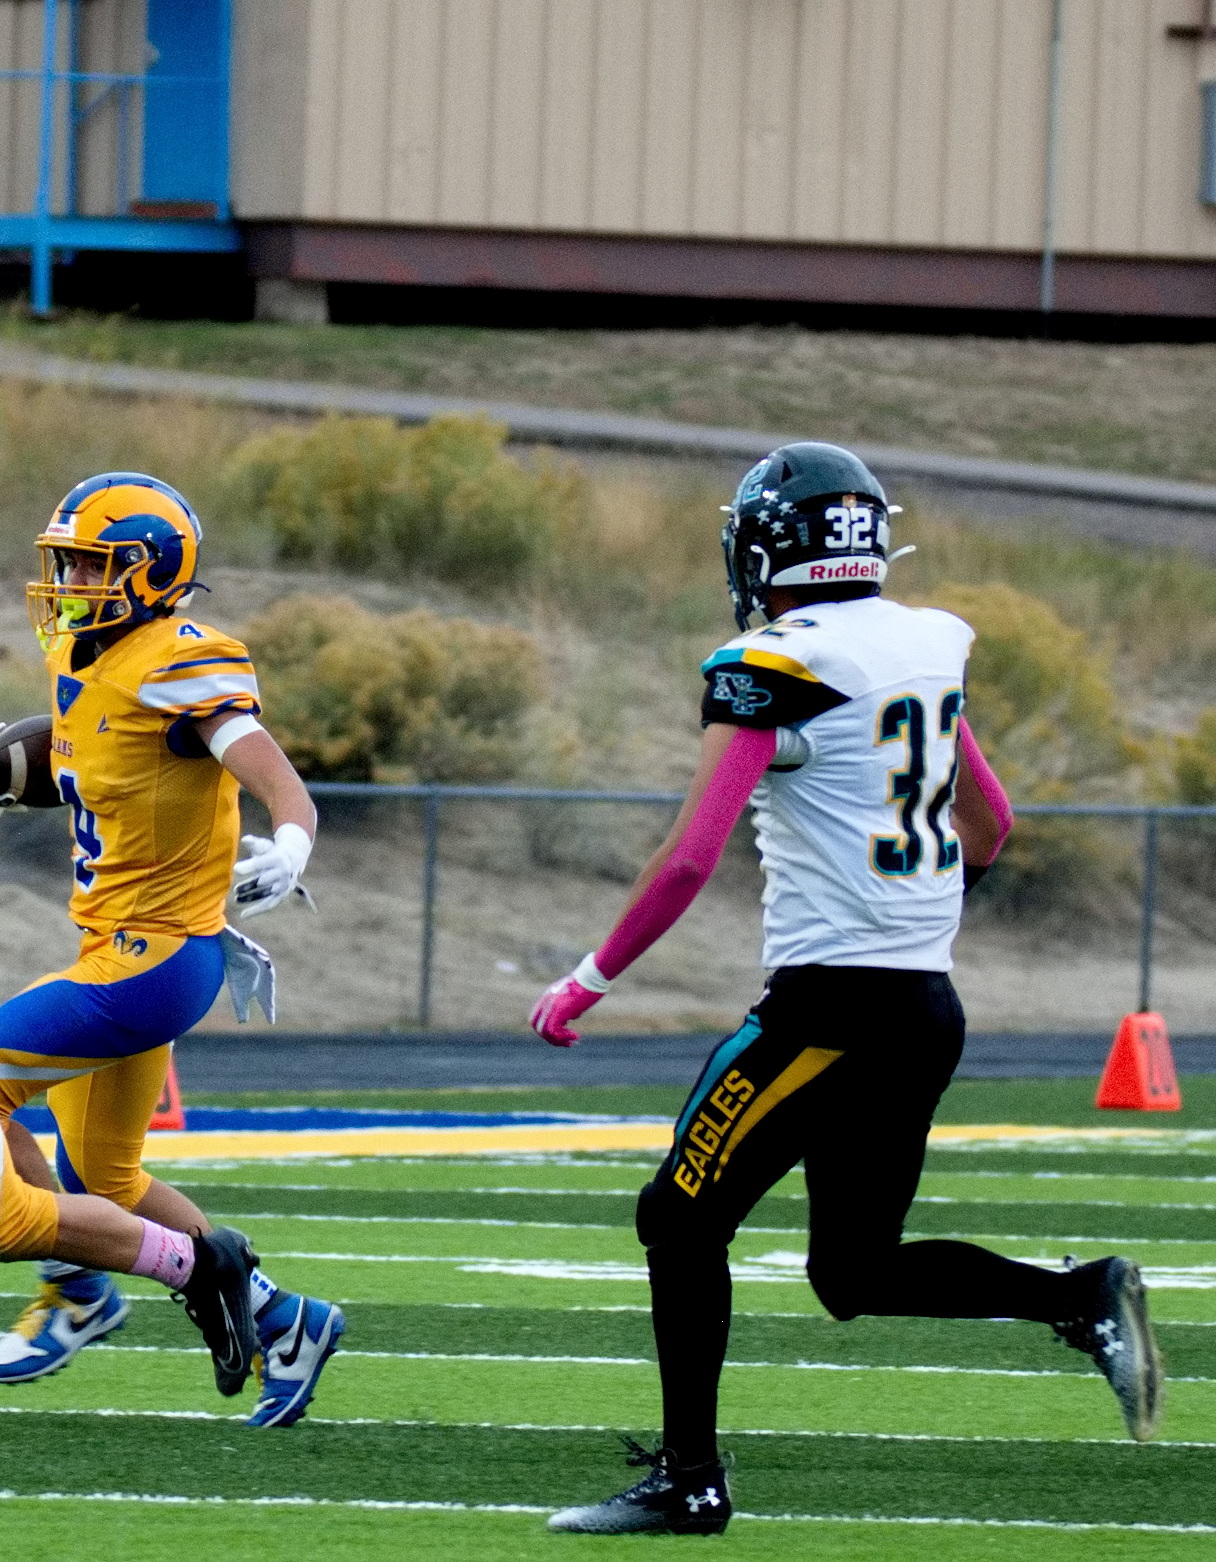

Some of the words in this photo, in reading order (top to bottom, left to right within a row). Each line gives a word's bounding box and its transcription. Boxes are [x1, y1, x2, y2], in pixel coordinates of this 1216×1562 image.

[825, 507, 872, 549] 32
[809, 562, 880, 580] Riddell
[176, 622, 205, 640] 4
[56, 766, 104, 895] 4
[673, 1069, 755, 1198] EAGLES
